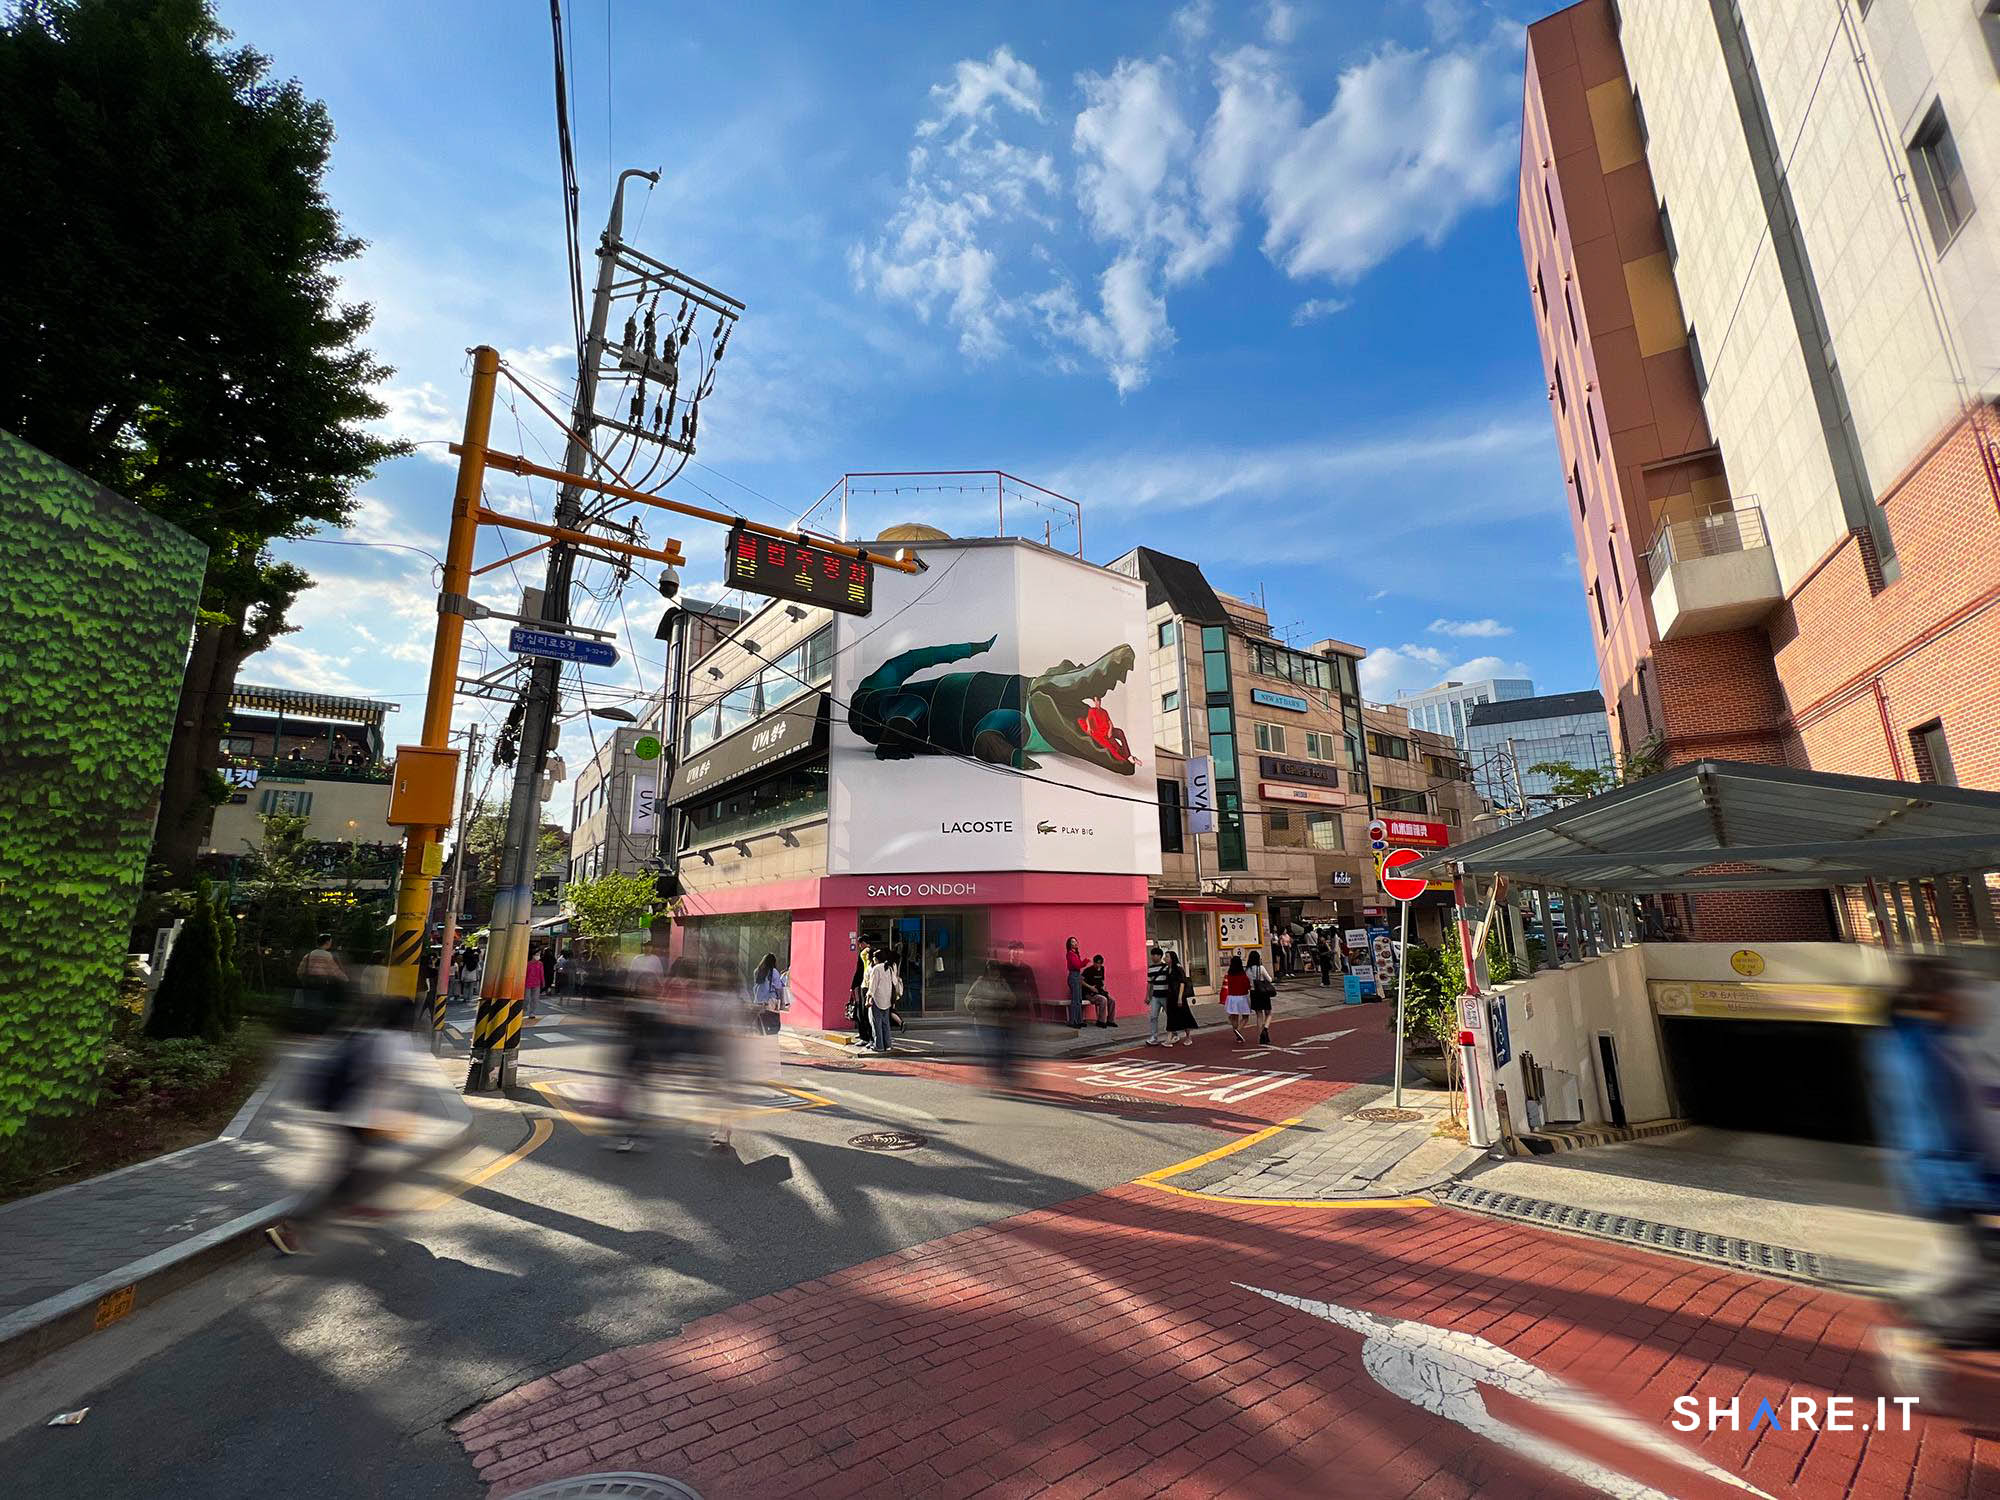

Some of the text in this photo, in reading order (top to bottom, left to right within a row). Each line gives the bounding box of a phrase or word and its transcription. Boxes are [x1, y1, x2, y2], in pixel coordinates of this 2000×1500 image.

[513, 643, 569, 658] Wangsimni-ro
[514, 633, 576, 651] 왕십리로5길
[752, 730, 770, 752] UVA
[770, 721, 787, 743] 성수
[686, 766, 700, 784] UVA
[1194, 775, 1208, 814] UVA
[638, 790, 653, 819] UVA
[941, 821, 1013, 834] LACOSTE
[1061, 827, 1094, 836] PLAY BIG
[867, 883, 976, 897] SAMO ONDOH
